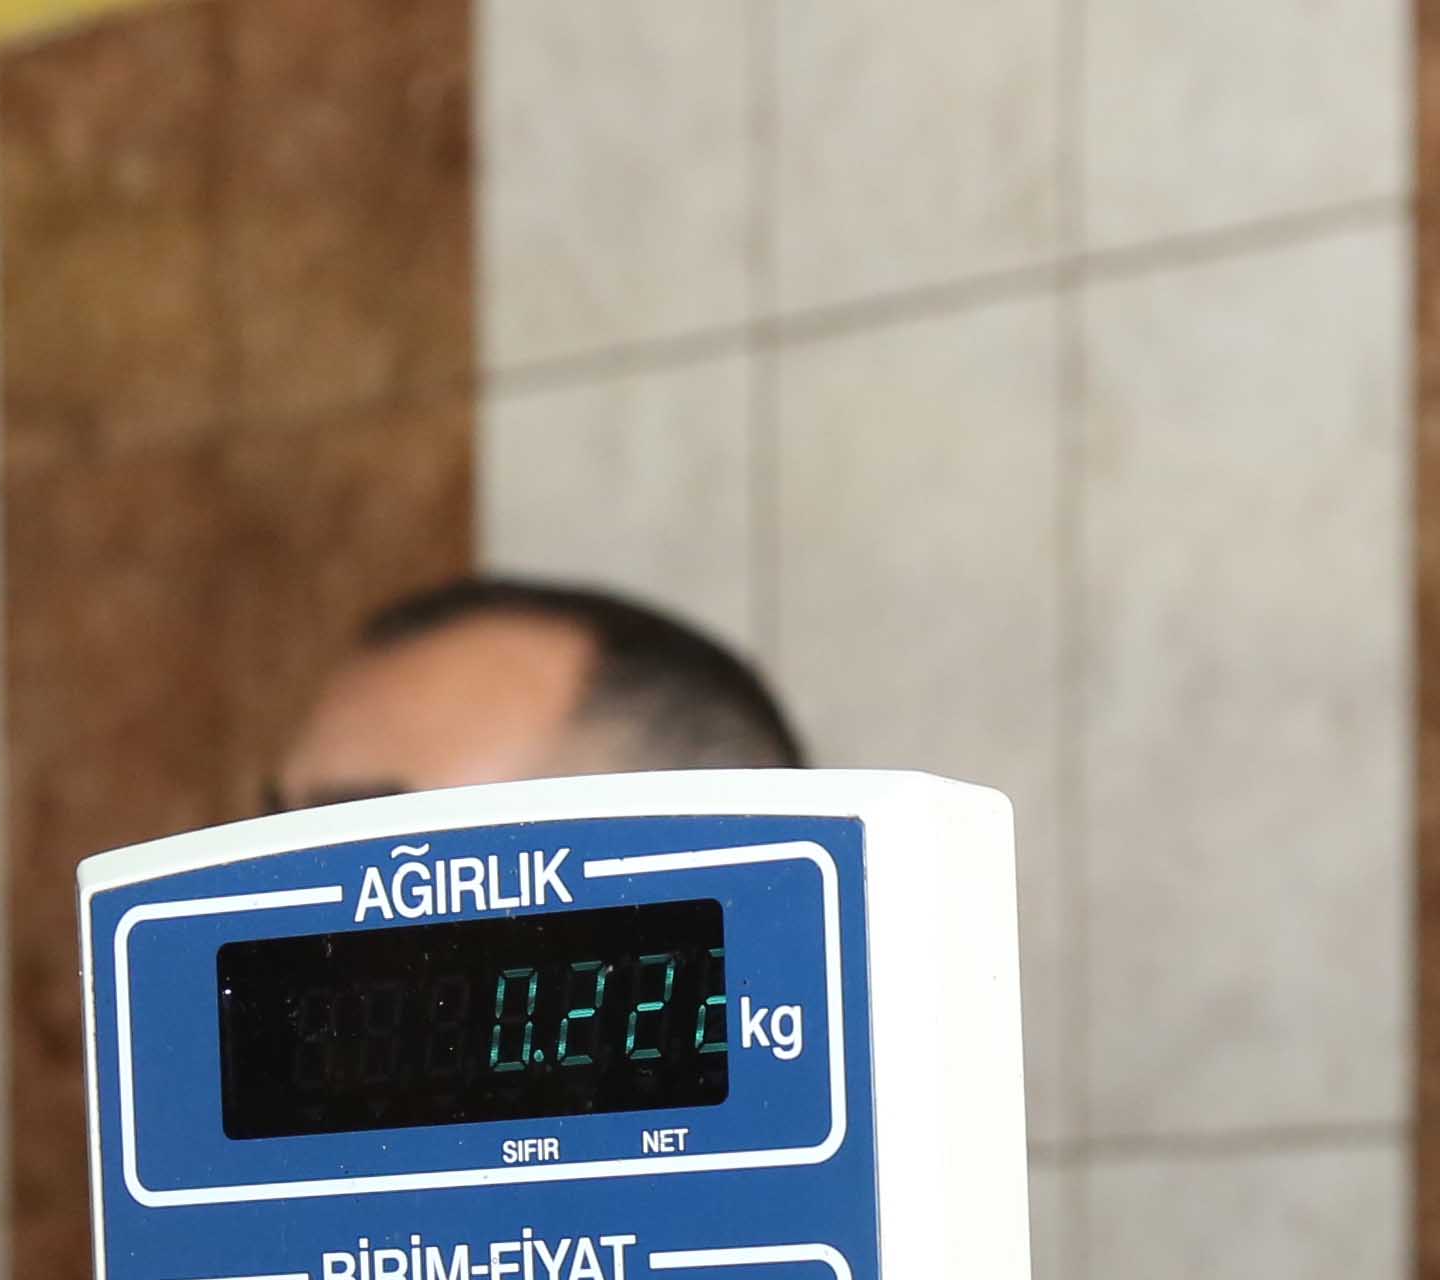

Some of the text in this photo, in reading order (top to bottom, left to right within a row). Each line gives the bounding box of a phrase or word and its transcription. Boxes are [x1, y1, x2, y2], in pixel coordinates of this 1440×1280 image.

[354, 843, 575, 924] AĞIRLIK
[739, 996, 803, 1059] kg
[502, 1128, 688, 1164] SIFIR NET
